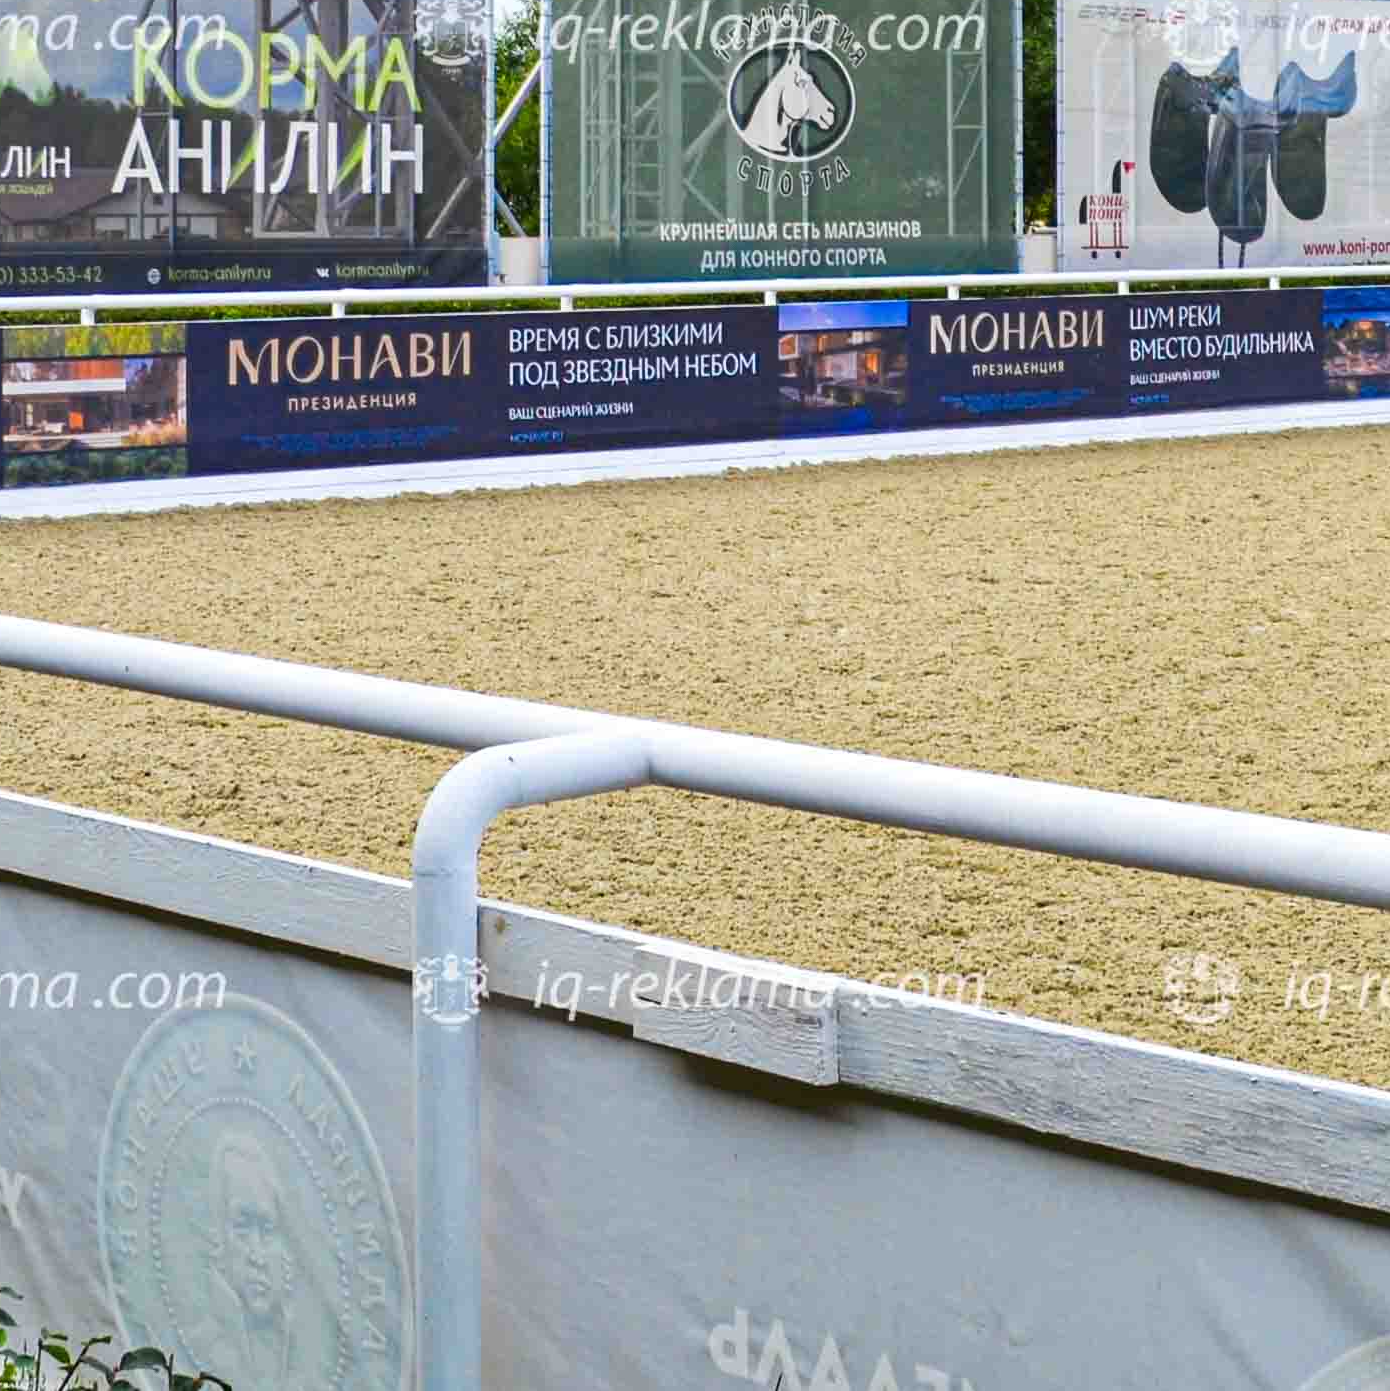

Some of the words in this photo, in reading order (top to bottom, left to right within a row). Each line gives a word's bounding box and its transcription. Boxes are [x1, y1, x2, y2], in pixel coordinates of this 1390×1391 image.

[132, 28, 423, 113] КОРМА
[111, 117, 424, 197] АНИЛИН
[735, 156, 853, 198] СПОРТА
[659, 219, 778, 243] КРУПНЕЙШАЯ
[782, 221, 822, 241] СЕТЬ
[824, 219, 923, 241] МАГАЗИНОВ
[18, 265, 103, 284] 333-53-42
[700, 250, 737, 274] ДЛЯ
[741, 248, 823, 270] КОННОГО
[825, 246, 888, 268] СПОРТА
[929, 309, 1105, 355] МОНАВИ
[1129, 308, 1174, 332] ШУМ
[1178, 305, 1221, 328] РЕКИ
[509, 326, 581, 354] ВРЕМЯ
[585, 325, 601, 351] С
[605, 320, 724, 349] БЛИЗКИМИ
[1129, 336, 1202, 362] ВМЕСТО
[1205, 330, 1315, 361] БУДИЛЬНИКА
[227, 330, 472, 388] МОНАВИ
[509, 360, 561, 393] ПОД
[563, 355, 681, 389] ЗВЕЗДНЫМ
[685, 352, 757, 380] НЕБОМ
[972, 360, 1065, 379] ПРЕЗИДЕНЦИЯ
[287, 391, 418, 414] ПРЕЗИДЕНЦИЯ
[509, 406, 533, 422] ВАШ
[535, 402, 592, 421] СЦЕНАРИЙ
[594, 401, 634, 417] ЖИЗНИ
